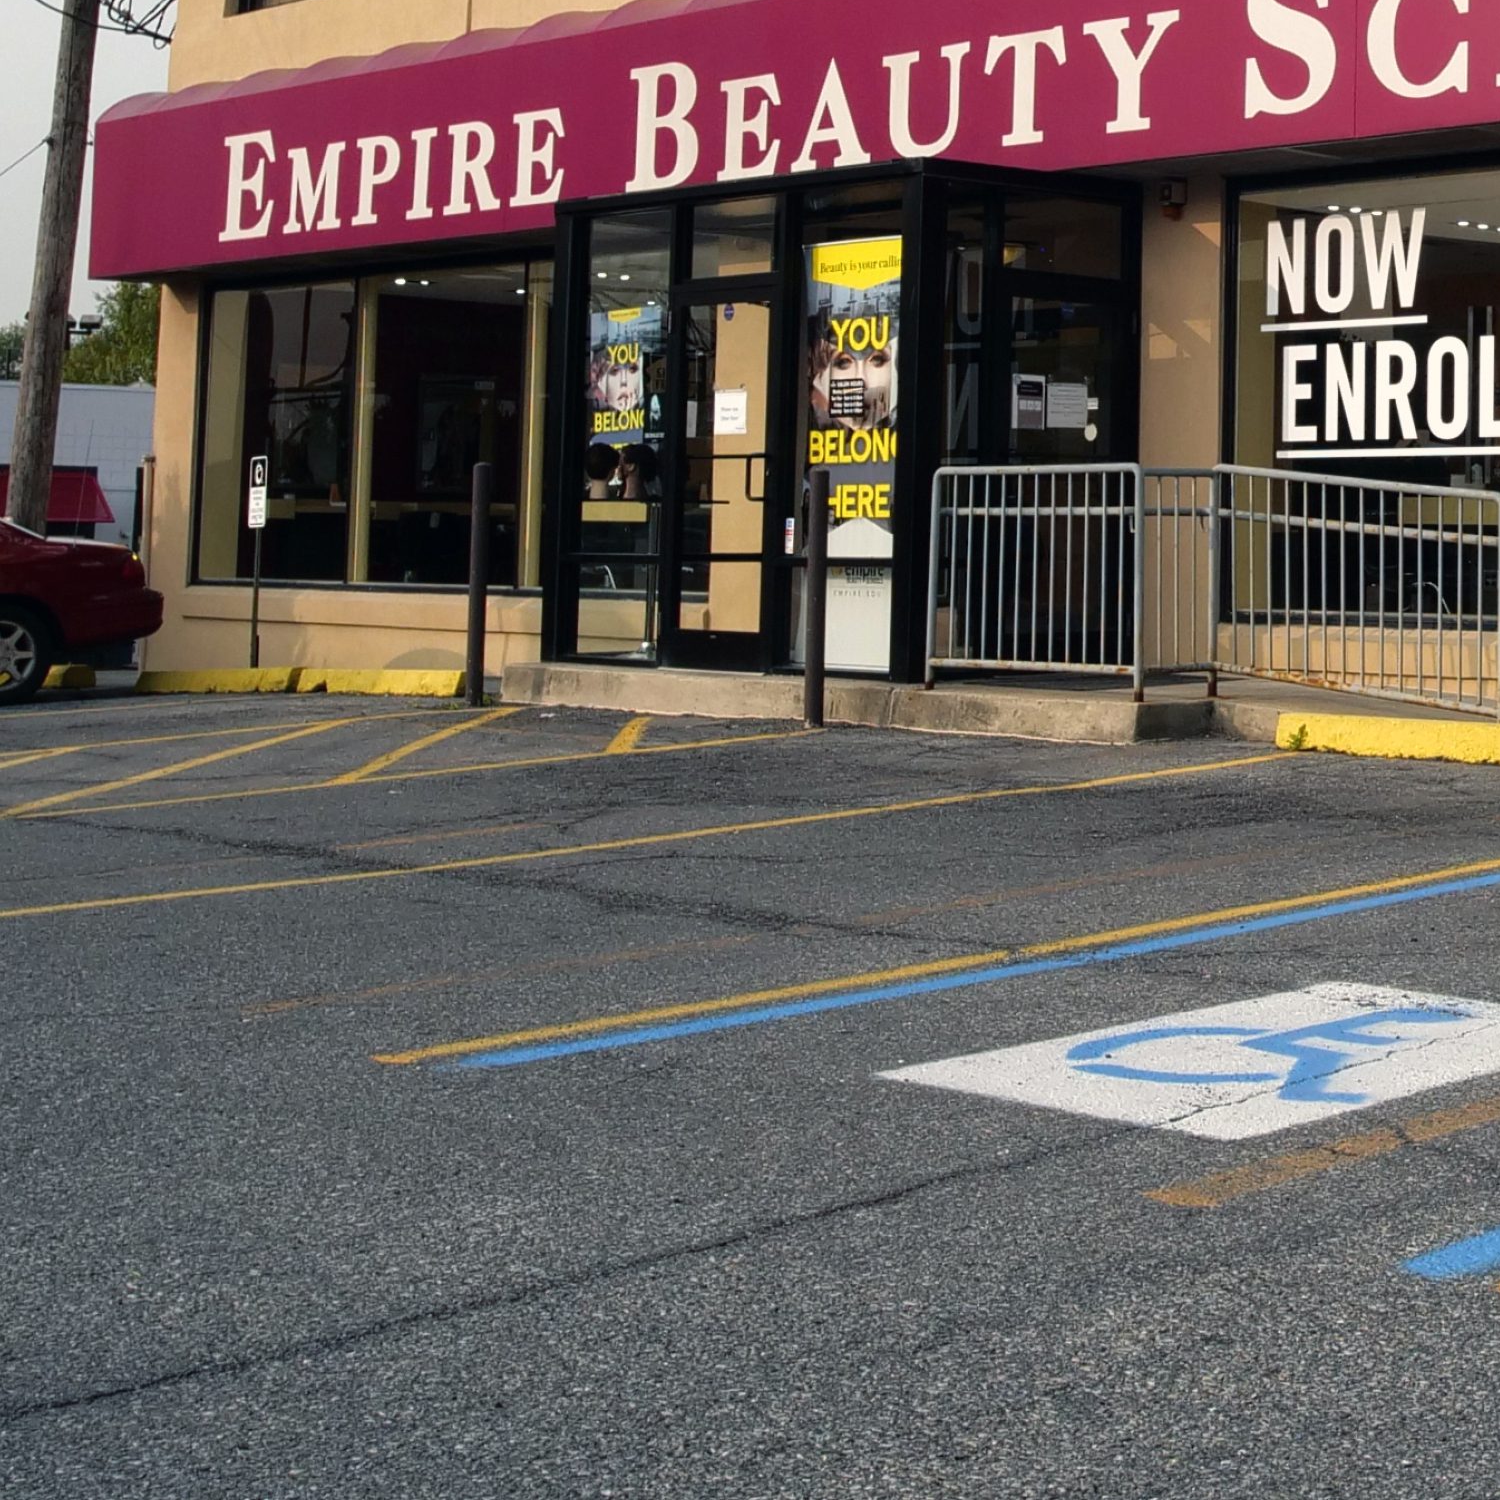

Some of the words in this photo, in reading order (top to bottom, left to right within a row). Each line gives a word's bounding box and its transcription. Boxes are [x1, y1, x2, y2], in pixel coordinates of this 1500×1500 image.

[218, 107, 566, 243] EMPIRE
[625, 9, 1181, 193] BEAUTY
[820, 262, 847, 275] Beauty
[858, 261, 877, 273] your
[1265, 207, 1426, 316] NOW
[831, 316, 890, 352] YOU
[608, 343, 639, 364] YOU
